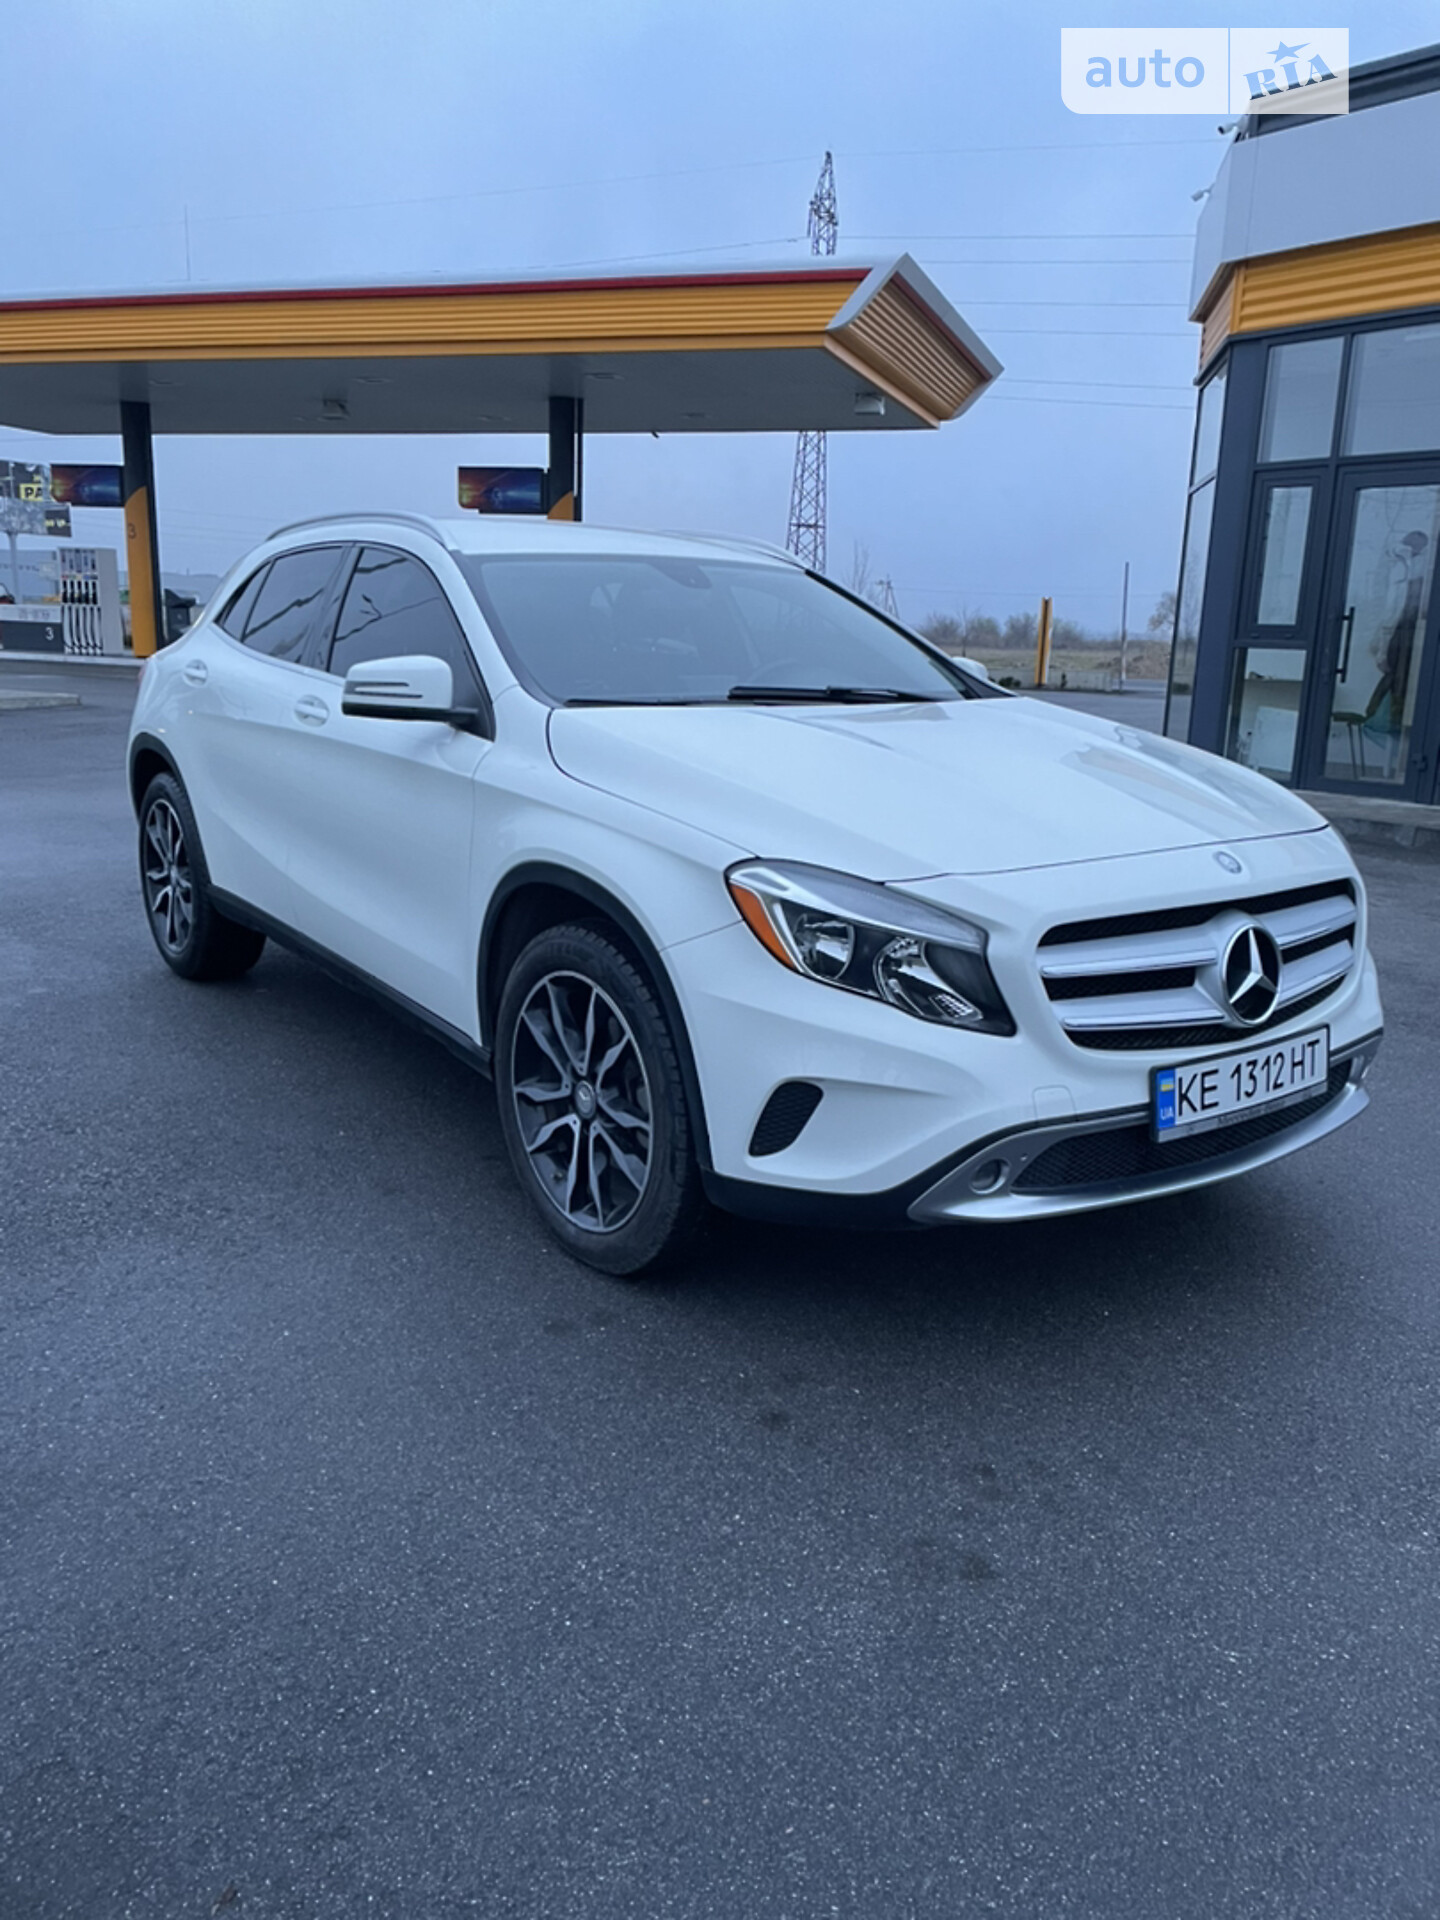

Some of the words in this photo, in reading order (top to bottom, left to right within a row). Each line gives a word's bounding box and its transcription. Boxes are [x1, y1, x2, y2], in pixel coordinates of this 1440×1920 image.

[128, 522, 137, 539] 3
[45, 626, 54, 641] 3
[1178, 1069, 1219, 1116] KE
[1230, 1052, 1285, 1101] 1312
[1290, 1039, 1320, 1084] HT
[1160, 1106, 1174, 1121] UA
